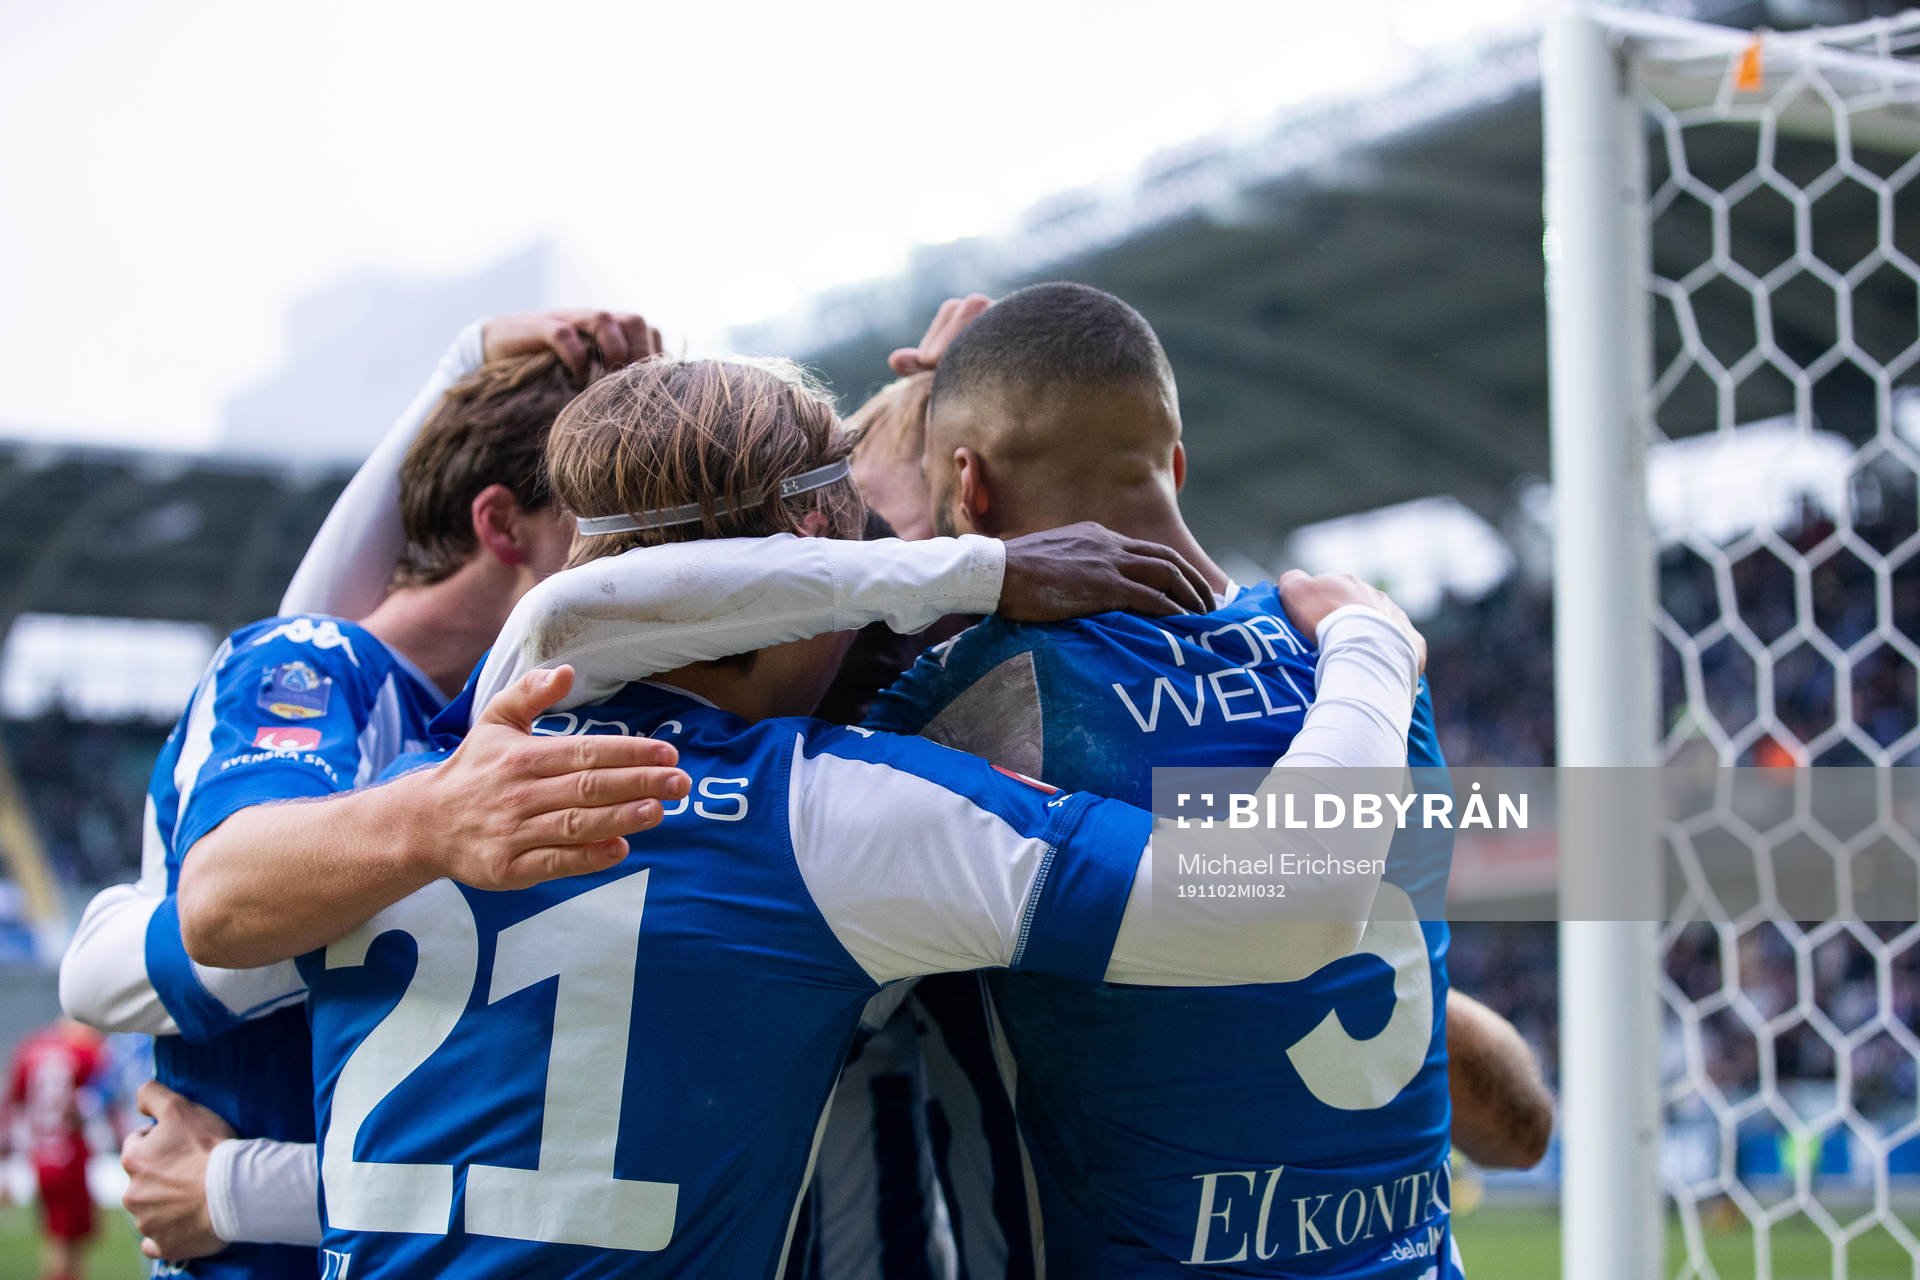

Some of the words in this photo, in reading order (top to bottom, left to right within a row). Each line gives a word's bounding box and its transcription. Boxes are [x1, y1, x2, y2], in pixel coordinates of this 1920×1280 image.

[221, 751, 299, 771] SVENSKA
[304, 754, 338, 784] SPEL
[322, 868, 679, 1251] 21
[1180, 1165, 1284, 1264] El
